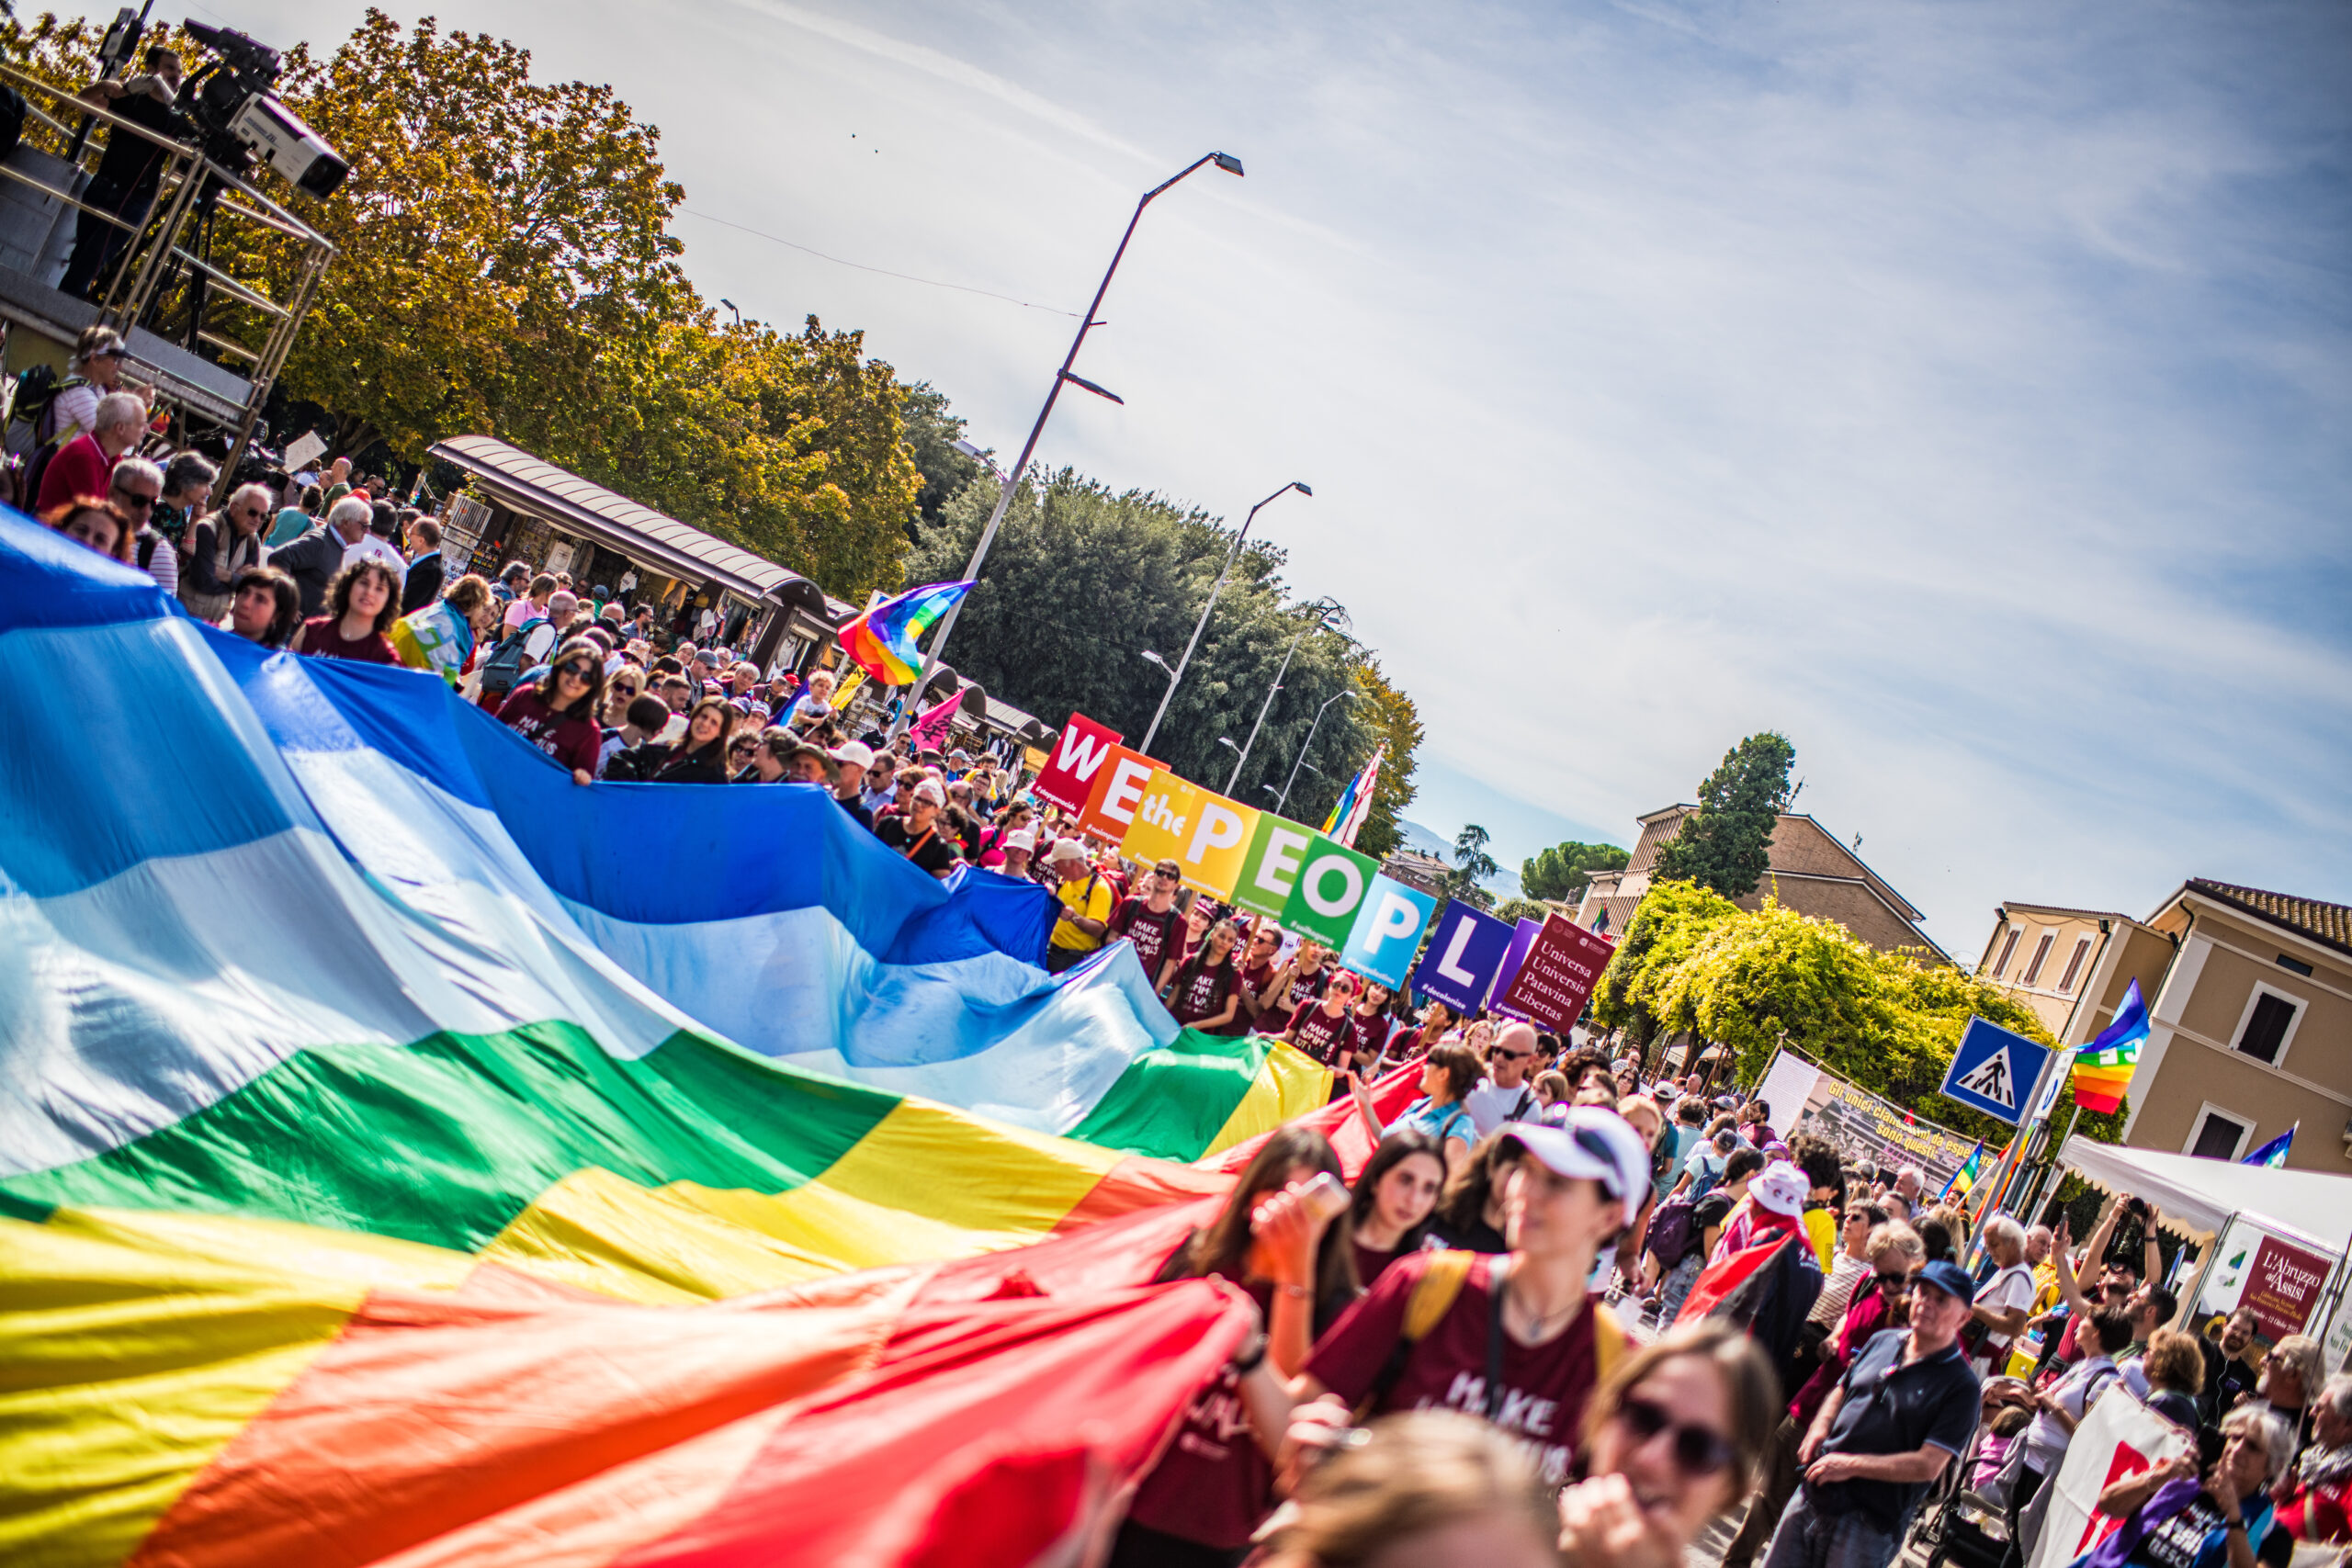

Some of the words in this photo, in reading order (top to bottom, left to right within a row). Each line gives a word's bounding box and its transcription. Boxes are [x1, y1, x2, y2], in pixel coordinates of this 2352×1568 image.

[1057, 724, 1110, 782] W
[1035, 784, 1077, 811] #stopgenocide
[1100, 757, 1152, 825] E
[1086, 823, 1124, 844] #noimpuni
[1141, 794, 1186, 837] the
[1185, 802, 1243, 864] P
[1254, 827, 1308, 897] E
[1302, 854, 1363, 918] O
[1135, 919, 1159, 936] MAKE
[1363, 891, 1420, 954] P
[1436, 915, 1477, 987] L
[1541, 940, 1592, 978] Universa
[1522, 970, 1573, 1008] Patavina
[1532, 955, 1587, 995] Universis
[1421, 983, 1467, 1010] #decolonize
[1513, 986, 1564, 1021] Libertas
[1306, 1021, 1333, 1040] MAKE
[1828, 1081, 1845, 1099] Gli
[1844, 1090, 1872, 1112] unici
[1931, 1131, 1943, 1147] da
[1946, 1138, 1994, 1168] espeere
[1875, 1122, 1903, 1145] sono
[1904, 1137, 1939, 1161] questi:
[2263, 1249, 2322, 1288] L'Abruzzo
[2269, 1271, 2308, 1303] Assisi
[1445, 1369, 1560, 1438] MKE
